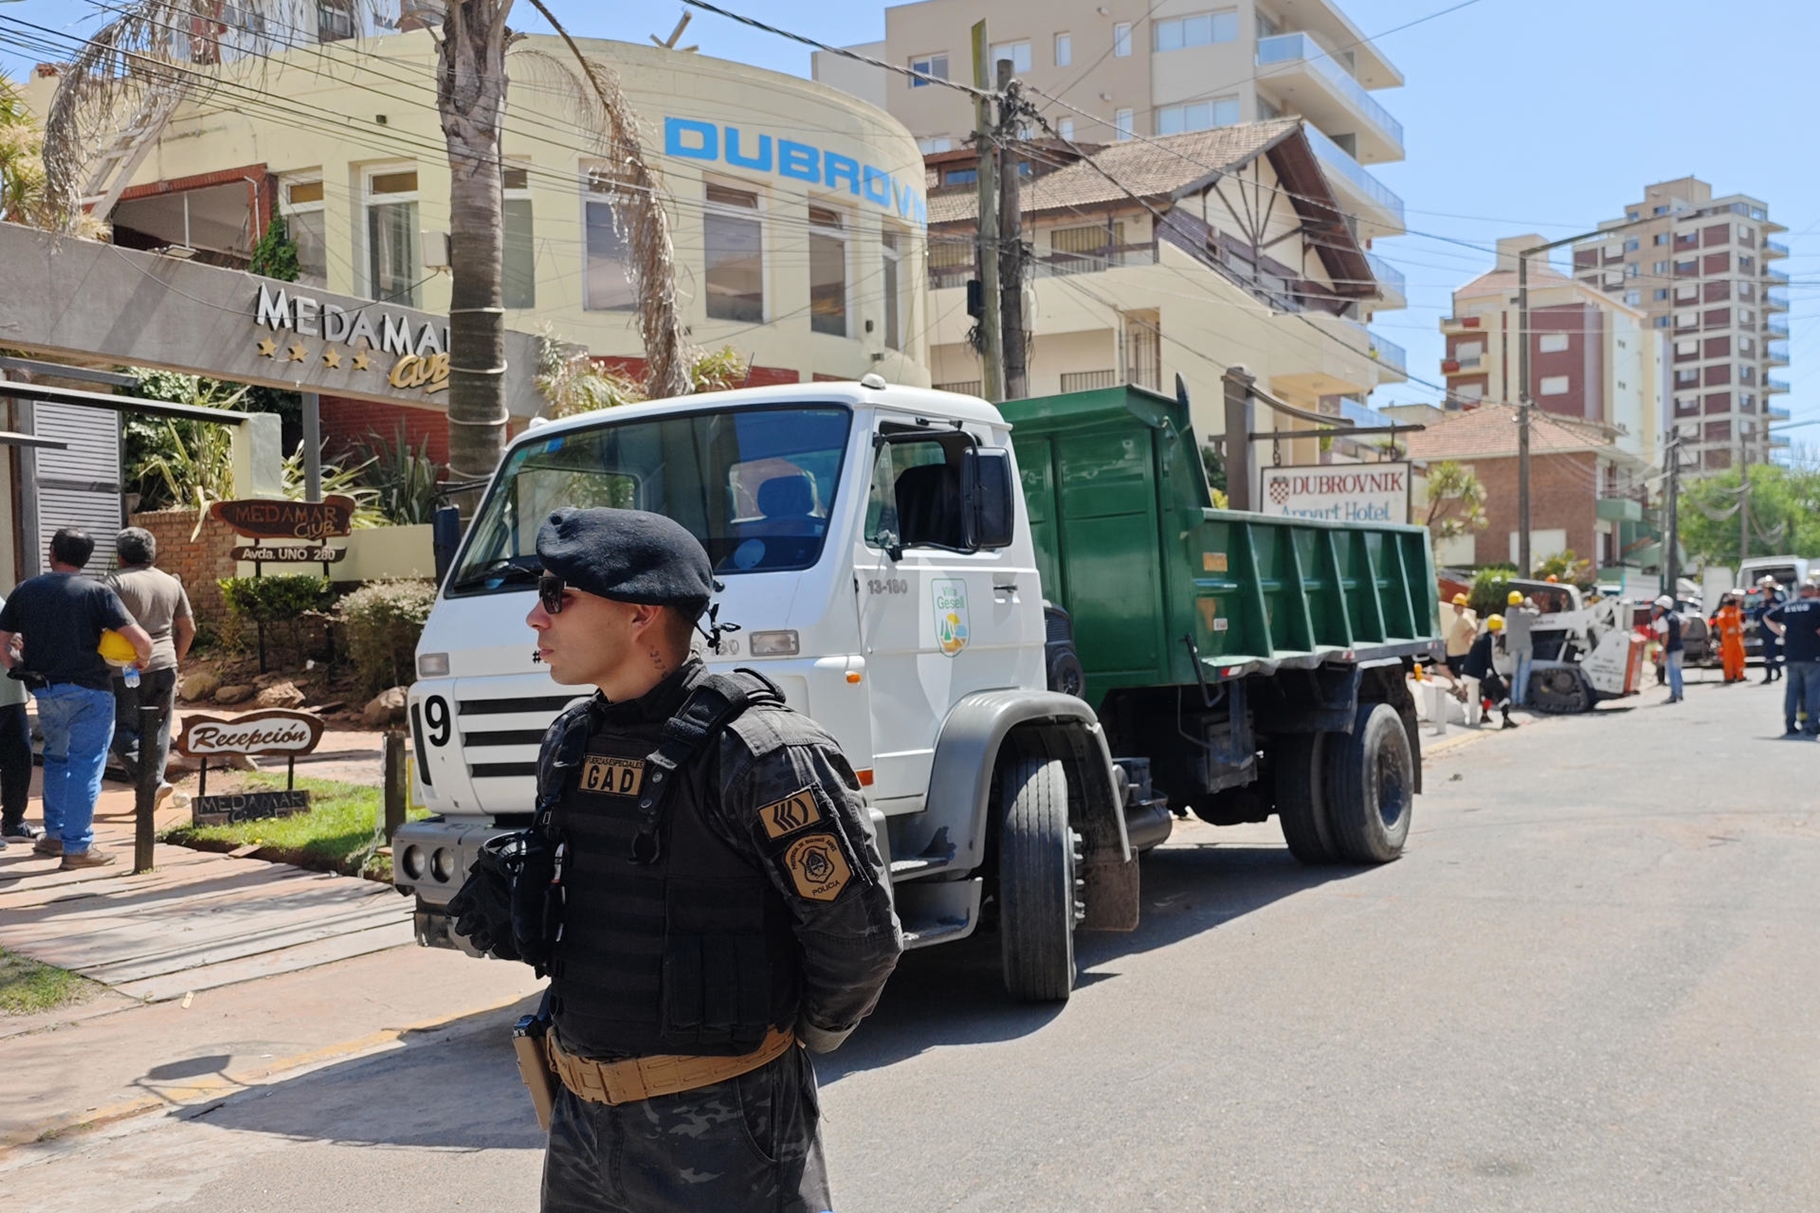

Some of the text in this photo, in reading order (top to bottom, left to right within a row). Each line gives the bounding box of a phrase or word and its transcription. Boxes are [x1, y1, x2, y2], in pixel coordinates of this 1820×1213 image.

[1292, 473, 1403, 496] DUBROVNIK
[235, 504, 338, 523] MEDAMAR
[1345, 501, 1390, 521] Hotel
[242, 548, 276, 560] Avda.
[278, 548, 308, 560] UNO
[867, 579, 908, 595] 13-180
[937, 596, 965, 610] Gesell
[424, 694, 452, 748] 9
[193, 722, 307, 751] Recepción
[587, 764, 635, 793] GAD
[811, 880, 841, 897] POLICIA
